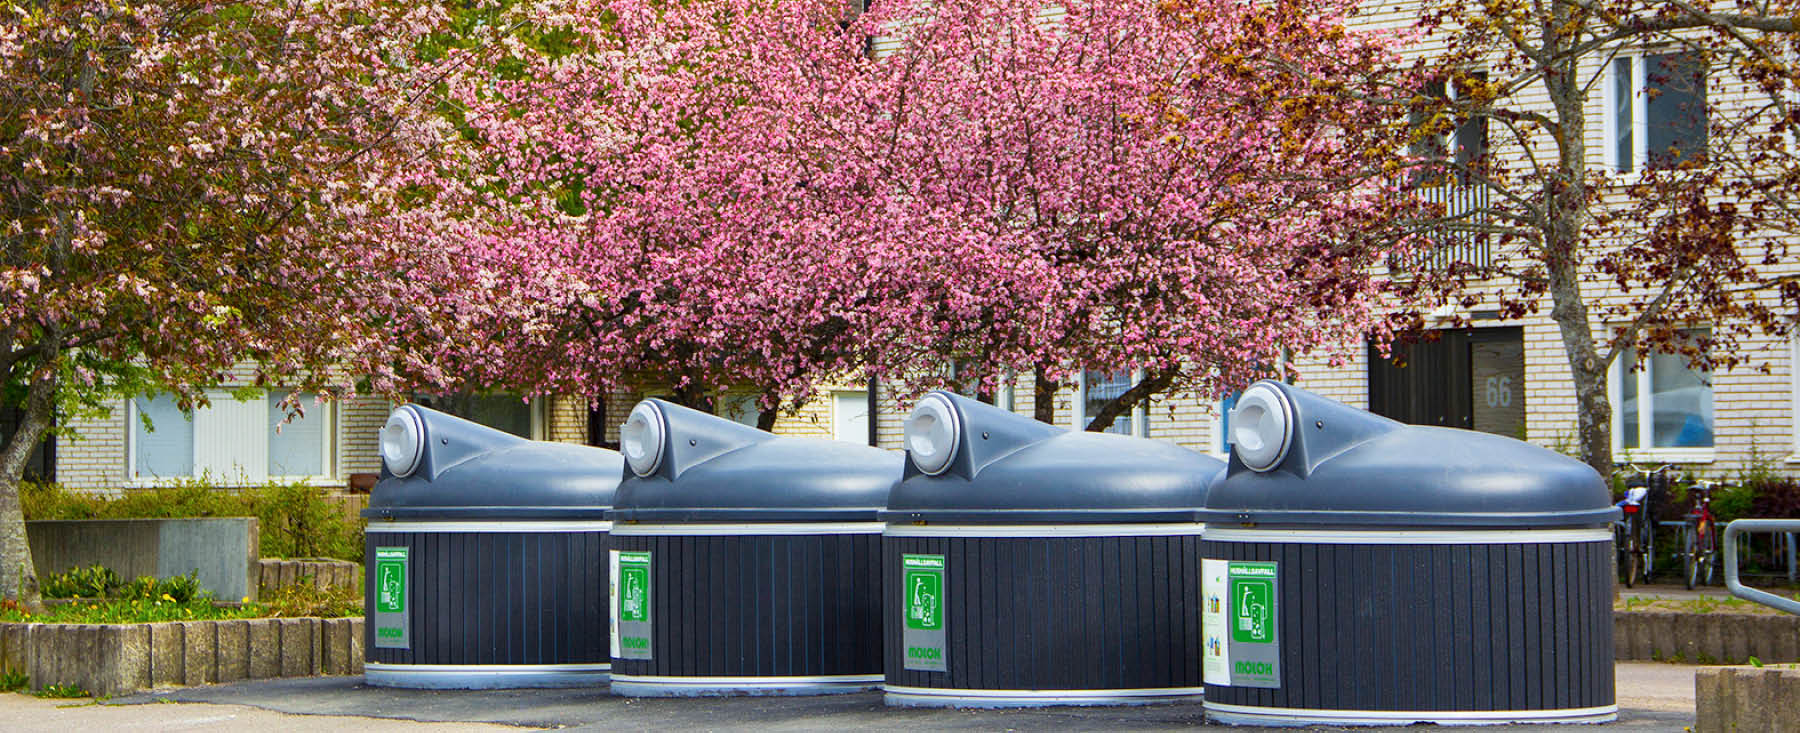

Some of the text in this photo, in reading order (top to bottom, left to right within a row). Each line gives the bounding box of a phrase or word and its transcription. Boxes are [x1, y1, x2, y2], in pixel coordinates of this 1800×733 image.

[1487, 377, 1512, 408] 66
[908, 647, 942, 660] MOLOK
[1235, 661, 1273, 676] MOLOK
